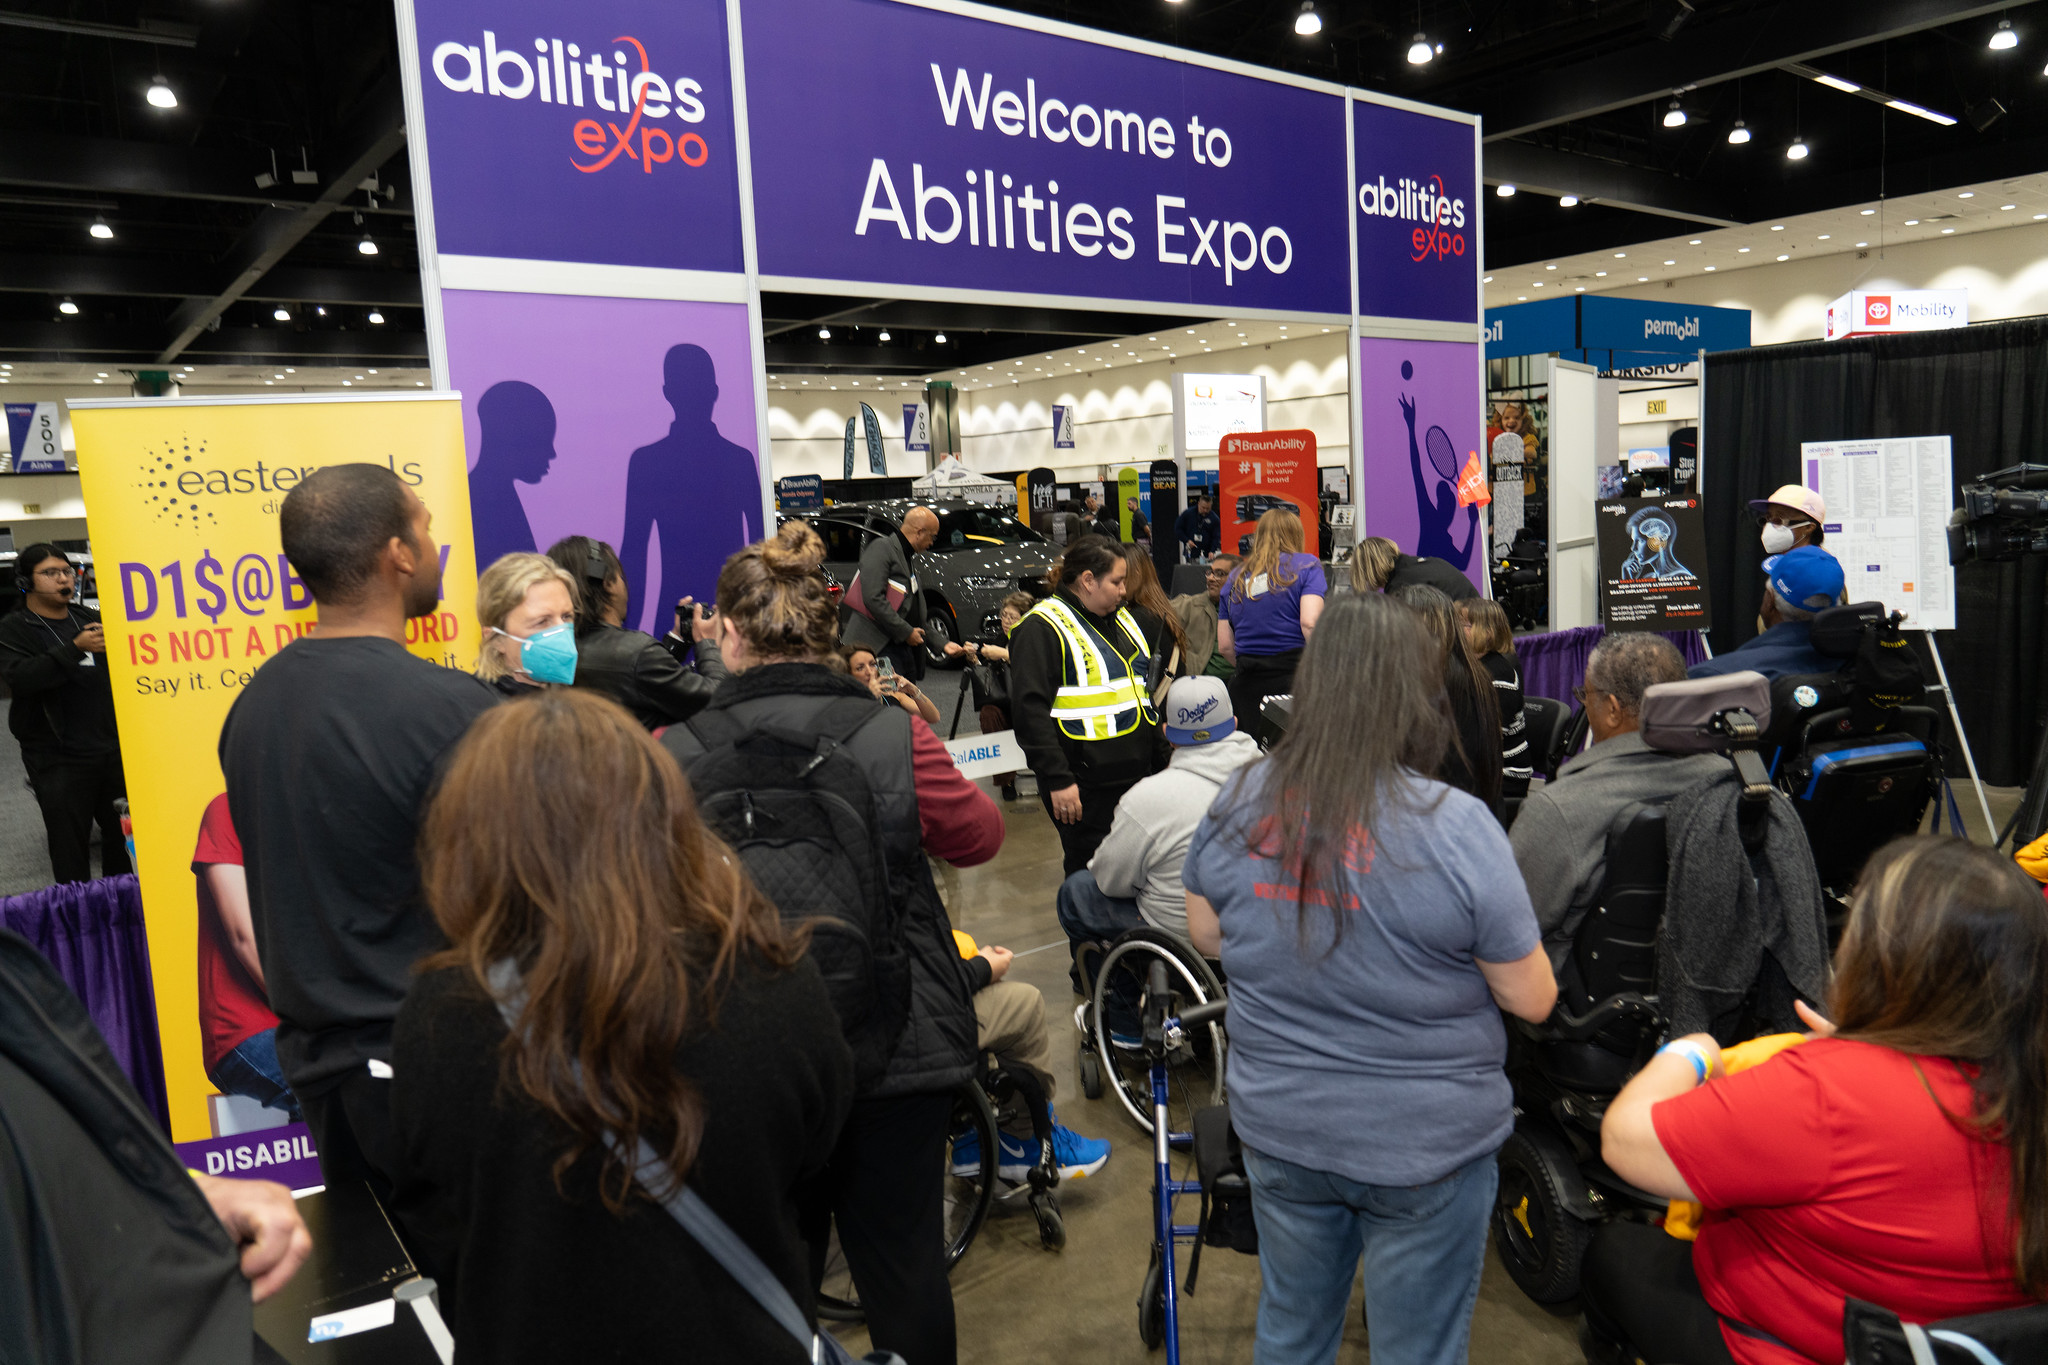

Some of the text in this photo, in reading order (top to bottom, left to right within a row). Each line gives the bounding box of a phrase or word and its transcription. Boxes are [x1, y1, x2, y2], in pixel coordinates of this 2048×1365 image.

[432, 29, 705, 123] abilities
[930, 62, 1232, 168] Welcome to
[571, 119, 708, 174] expo
[1359, 175, 1465, 228] abilities
[855, 158, 1293, 287] Abilities Expo
[1411, 228, 1465, 261] expo
[1897, 303, 1956, 319] Mobility
[1644, 316, 1699, 341] permobil
[1648, 401, 1665, 414] EXIT
[40, 415, 55, 455] 500
[918, 411, 927, 440] 900
[1242, 439, 1306, 452] BraunAbility
[1152, 482, 1177, 490] GEAR
[1238, 460, 1262, 484] #1
[128, 633, 159, 666] IS
[168, 627, 233, 663] NOT
[245, 625, 267, 657] A
[405, 612, 459, 645] ORD
[135, 675, 181, 698] Say
[189, 671, 212, 691] it.
[1178, 694, 1219, 725] Dodgers
[205, 1135, 318, 1176] DISABIL
